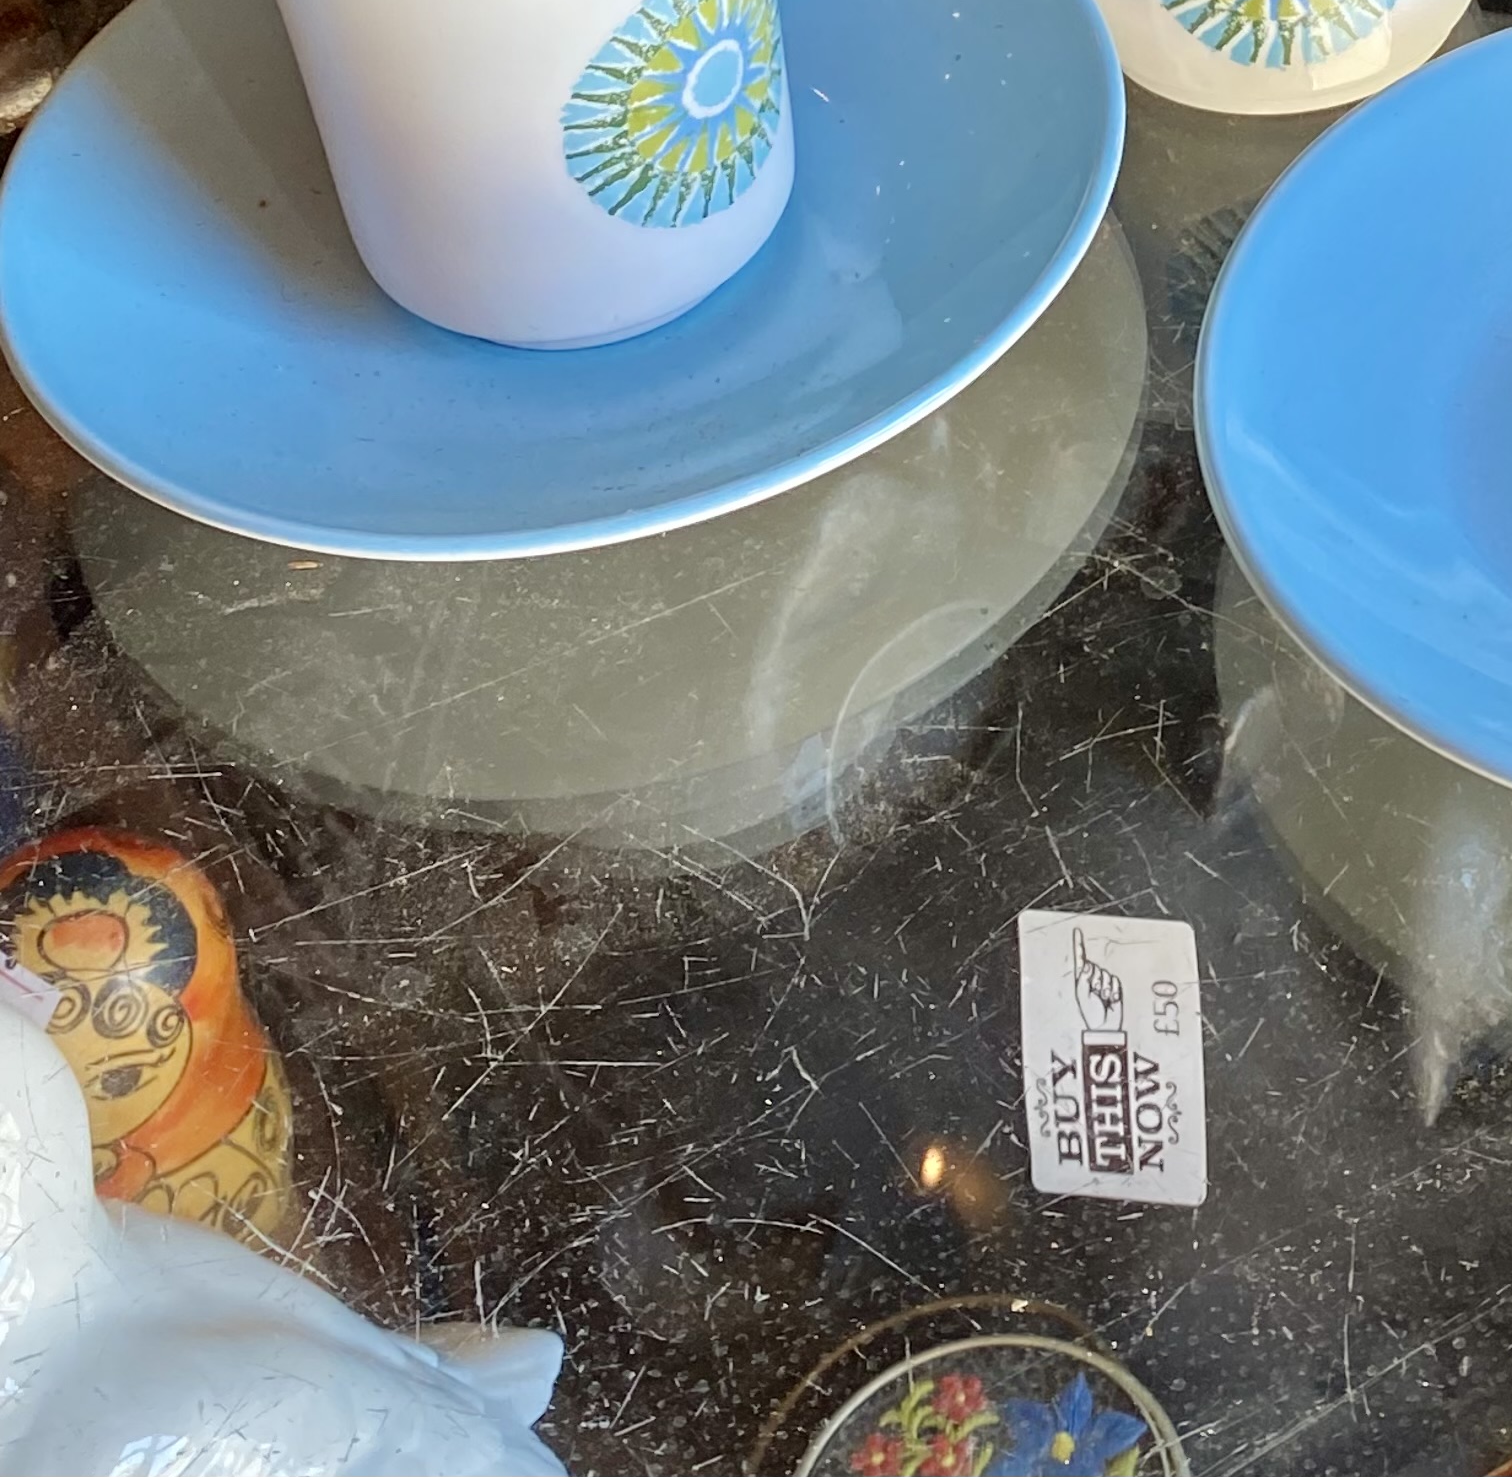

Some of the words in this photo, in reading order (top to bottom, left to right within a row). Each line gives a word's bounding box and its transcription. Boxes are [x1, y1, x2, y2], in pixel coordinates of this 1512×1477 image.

[1151, 980, 1180, 1036] £50
[1051, 1050, 1083, 1166] BUY
[1089, 1054, 1126, 1167] THIS
[1133, 1052, 1164, 1172] NOW
